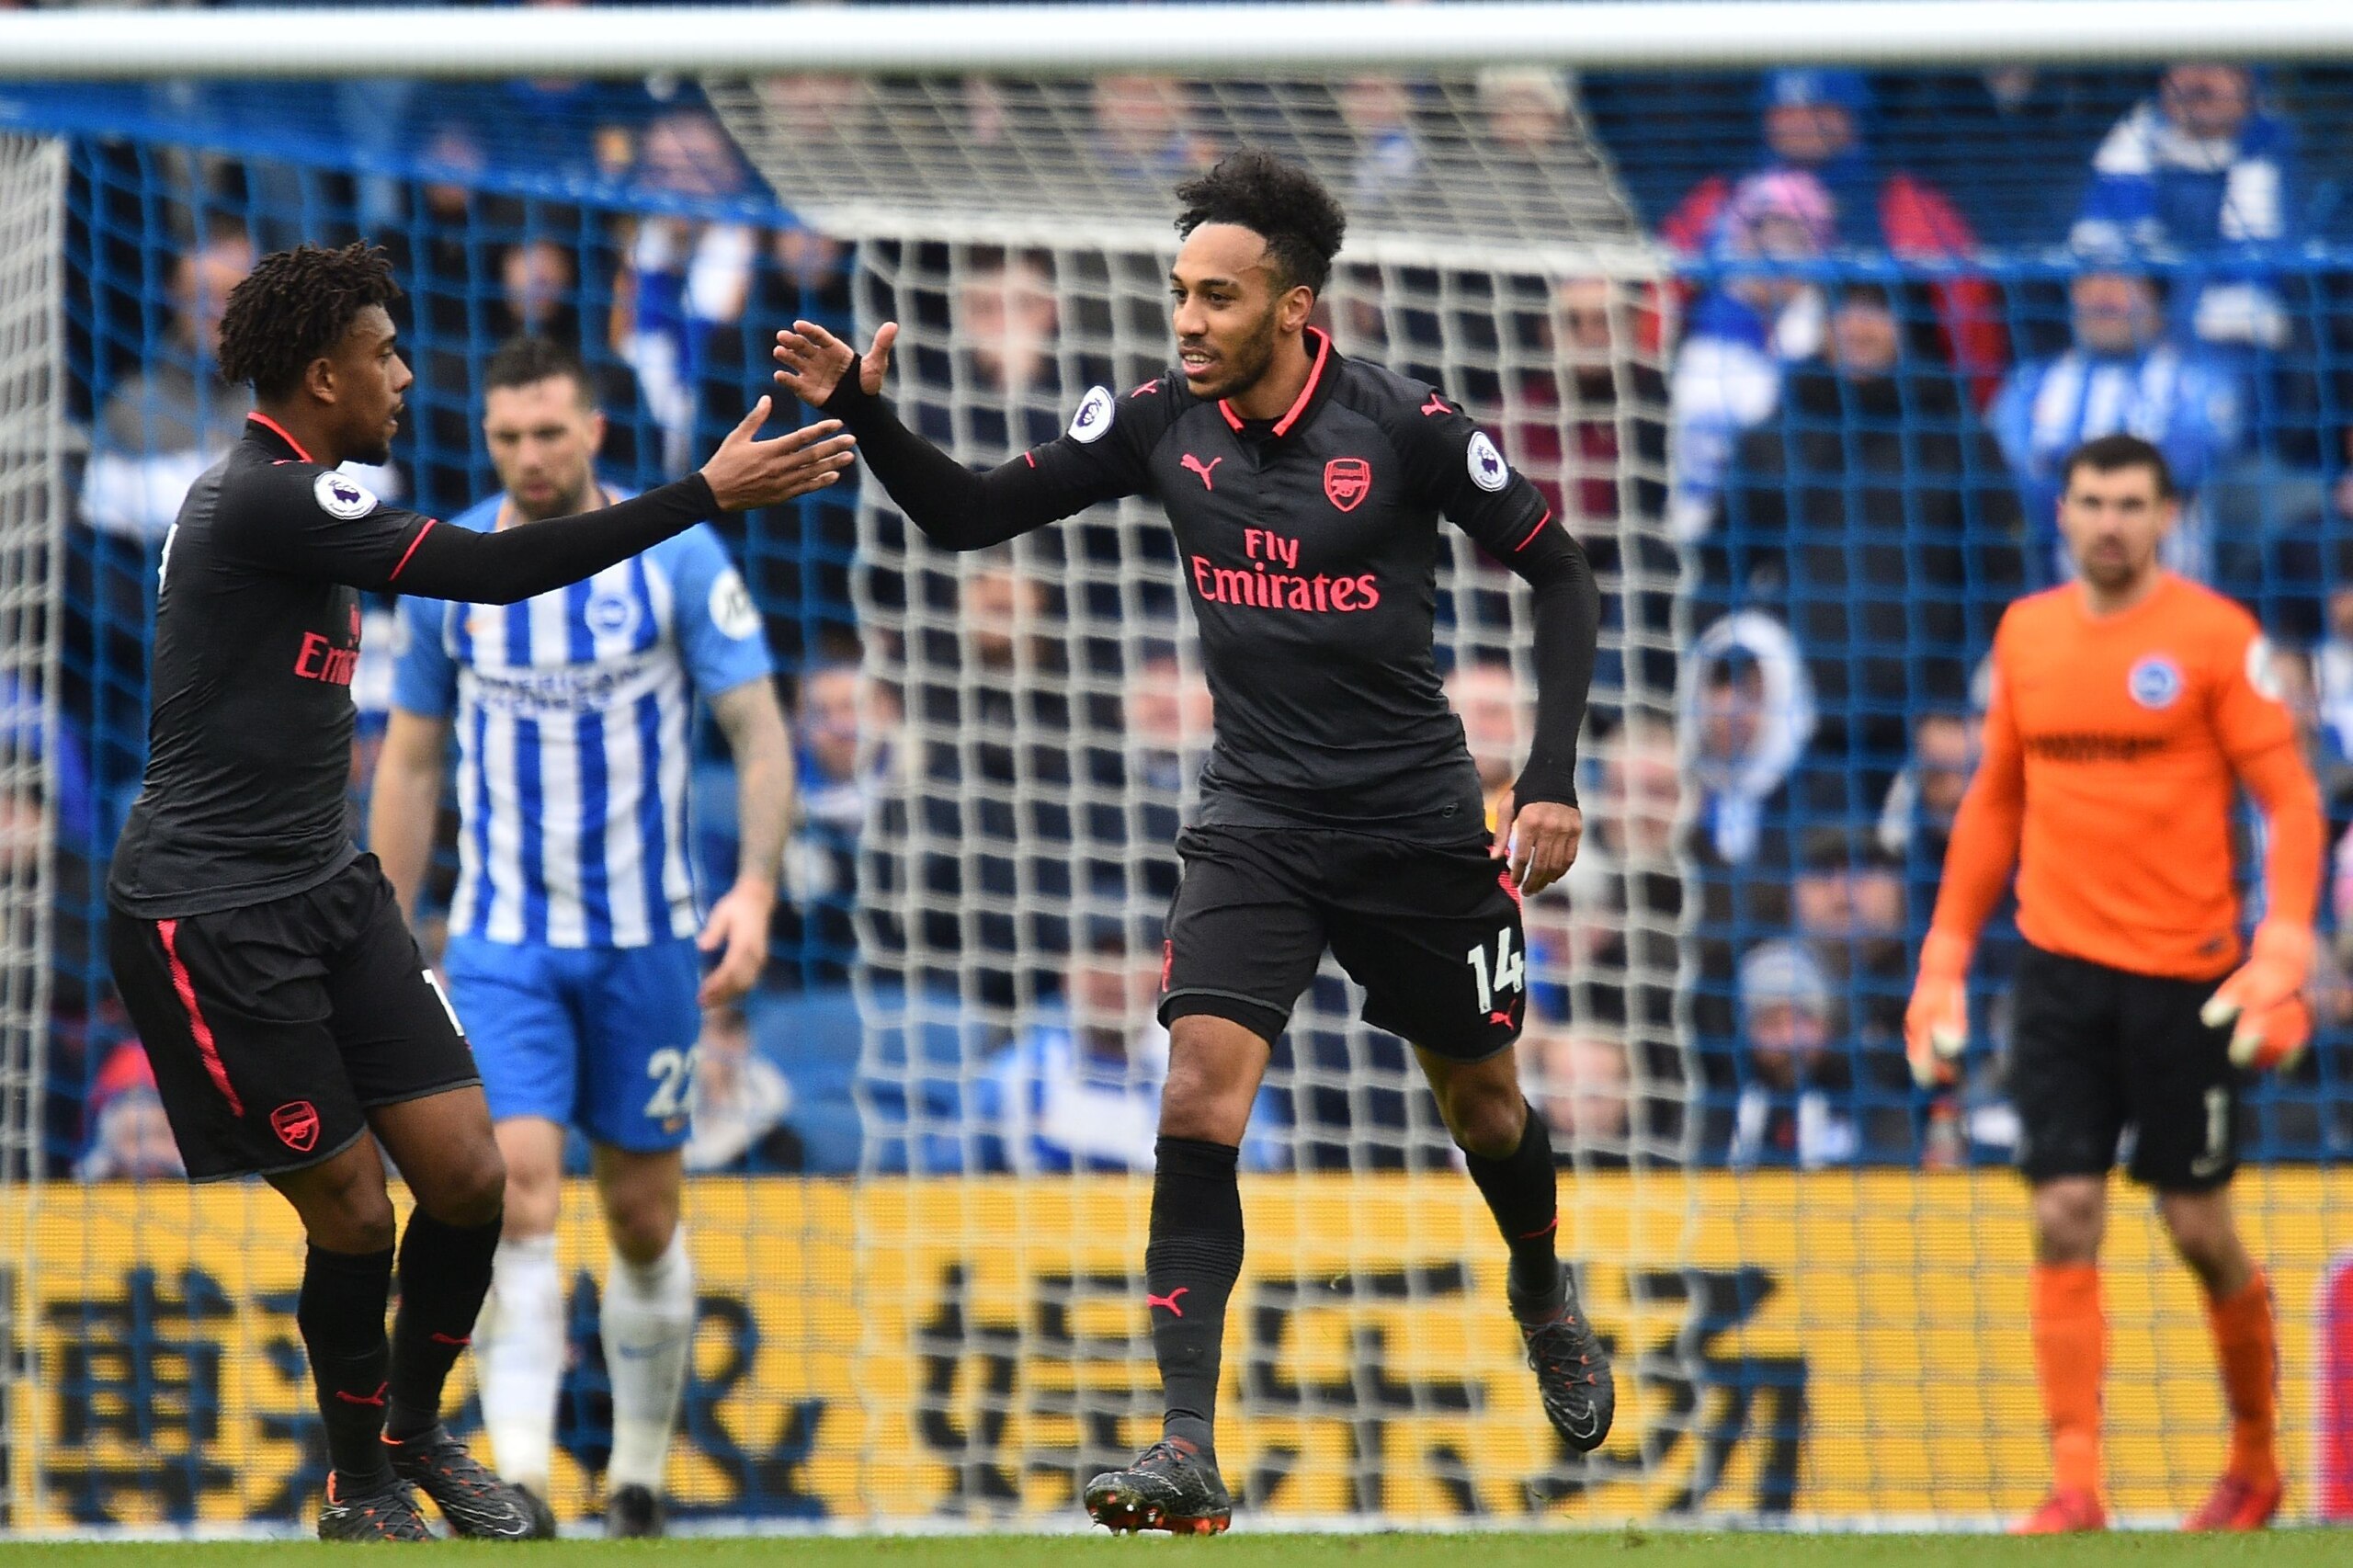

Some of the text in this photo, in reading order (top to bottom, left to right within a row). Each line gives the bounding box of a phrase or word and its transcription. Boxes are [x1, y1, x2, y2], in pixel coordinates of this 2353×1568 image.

[1244, 528, 1300, 570] Fly
[1191, 554, 1381, 612] Emirates
[1466, 926, 1525, 1015] 14
[2203, 1086, 2229, 1154] 1
